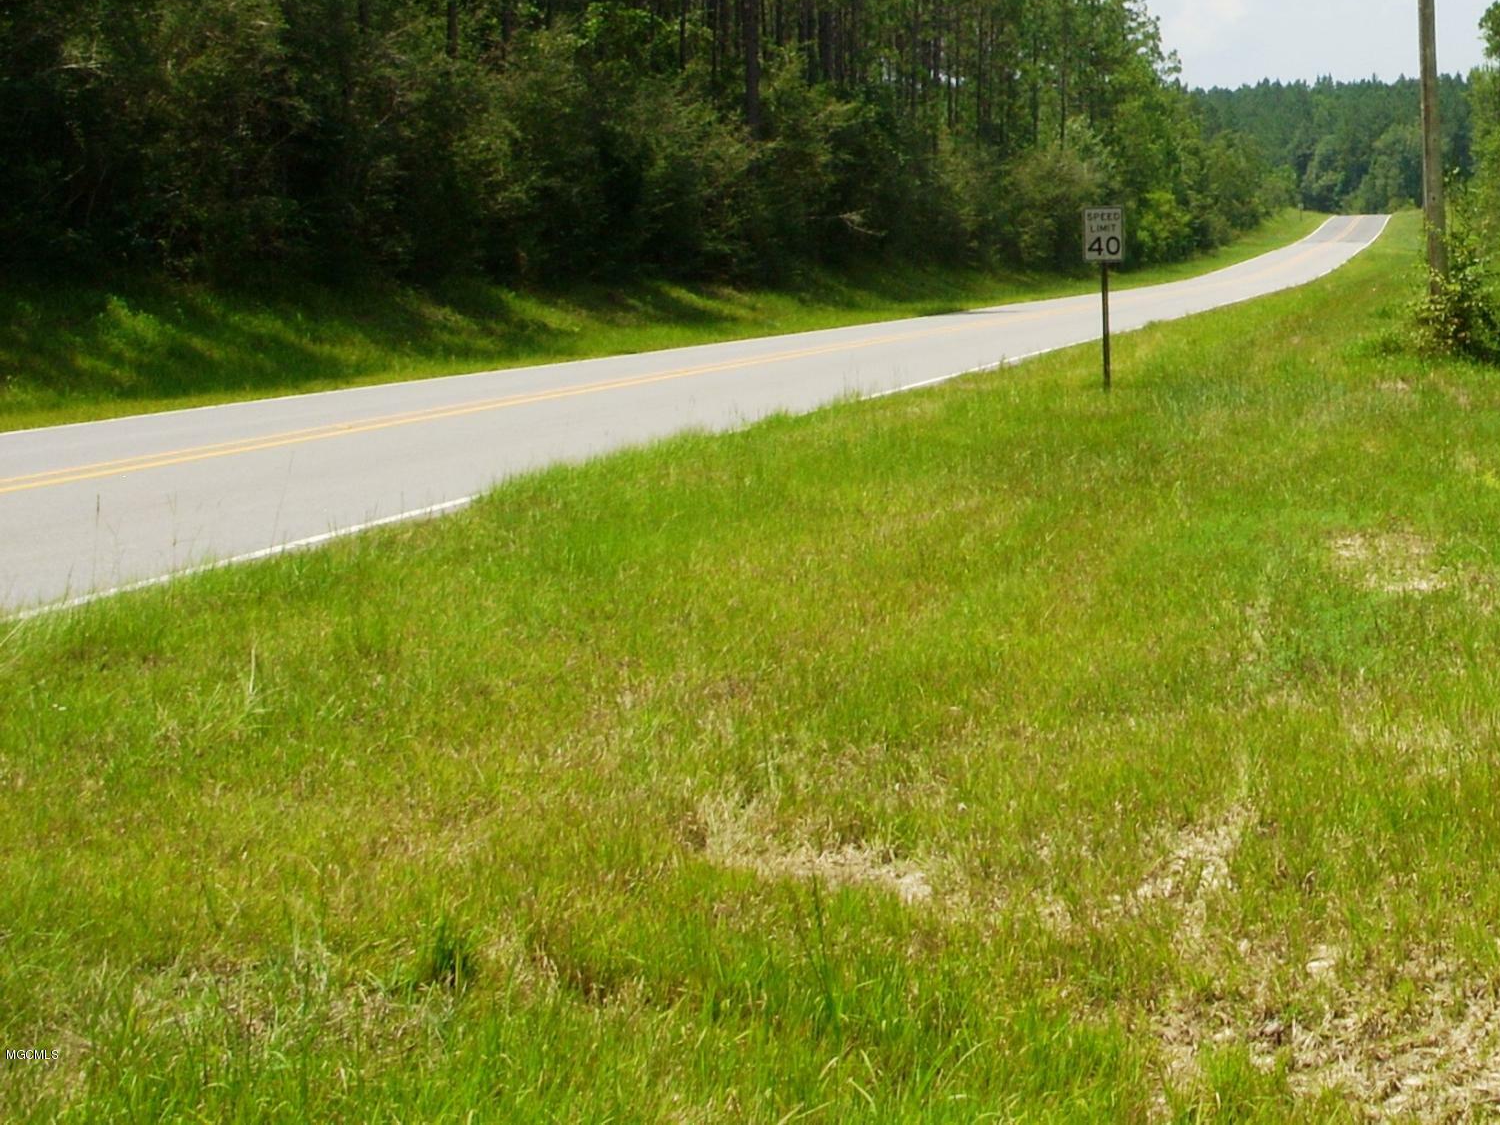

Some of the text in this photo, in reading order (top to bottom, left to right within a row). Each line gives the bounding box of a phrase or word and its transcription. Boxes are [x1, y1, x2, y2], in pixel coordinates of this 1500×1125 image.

[1087, 212, 1120, 221] SPEED
[1090, 224, 1116, 233] LIMIT
[1087, 236, 1121, 256] 40
